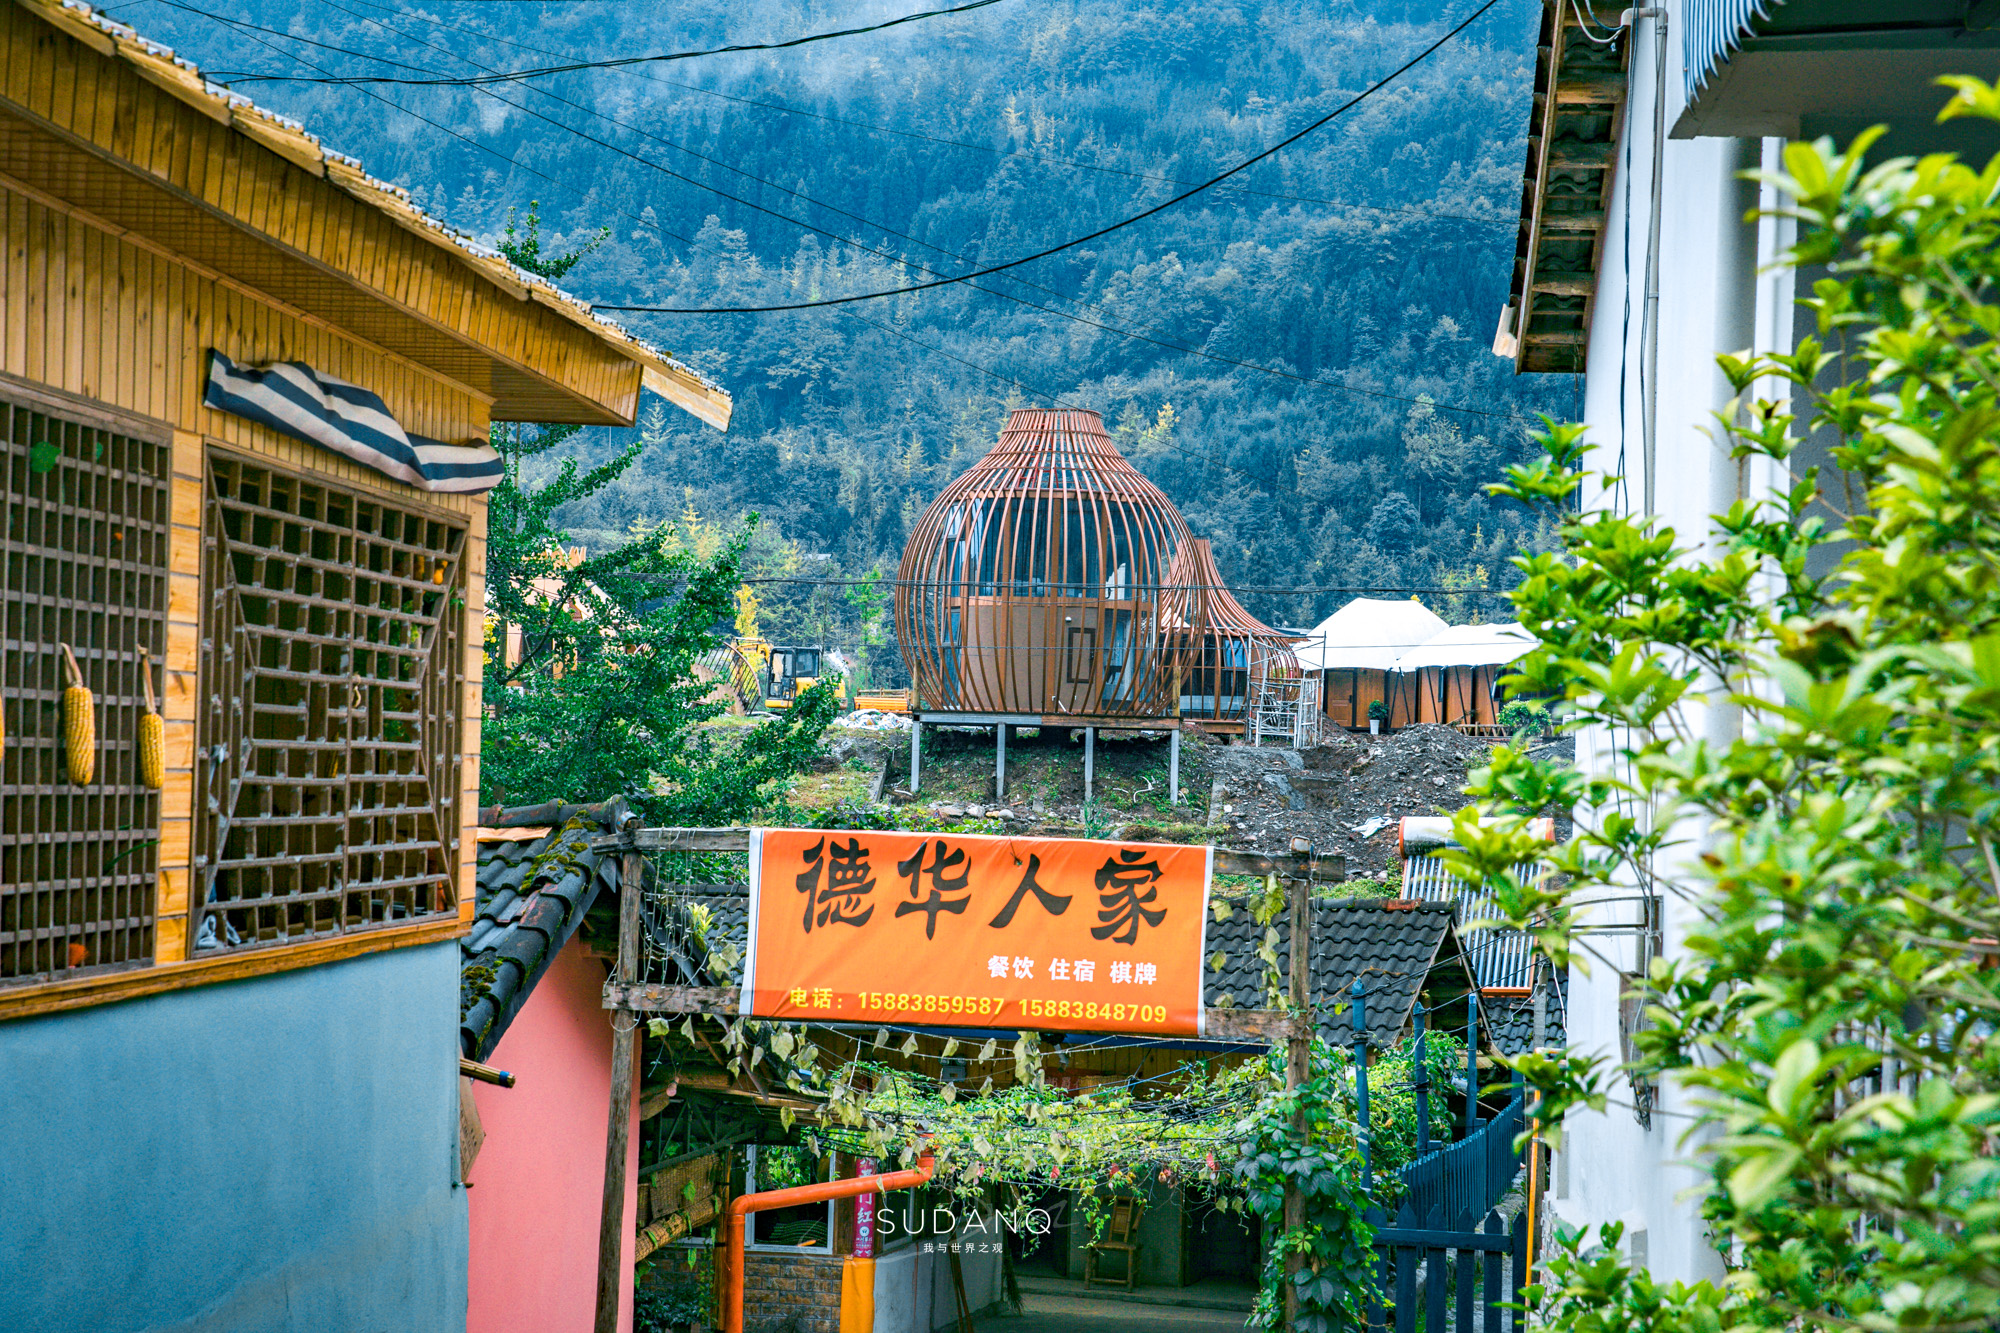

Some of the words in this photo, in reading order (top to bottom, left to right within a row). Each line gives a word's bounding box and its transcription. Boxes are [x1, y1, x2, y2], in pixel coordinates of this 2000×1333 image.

[796, 835, 1168, 946] 德华人家
[987, 956, 1034, 980] 餐饮
[1048, 958, 1095, 983] 住宿
[1109, 961, 1157, 985] 棋牌
[858, 992, 1004, 1016] 15883859587
[1018, 999, 1168, 1024] 15883848709
